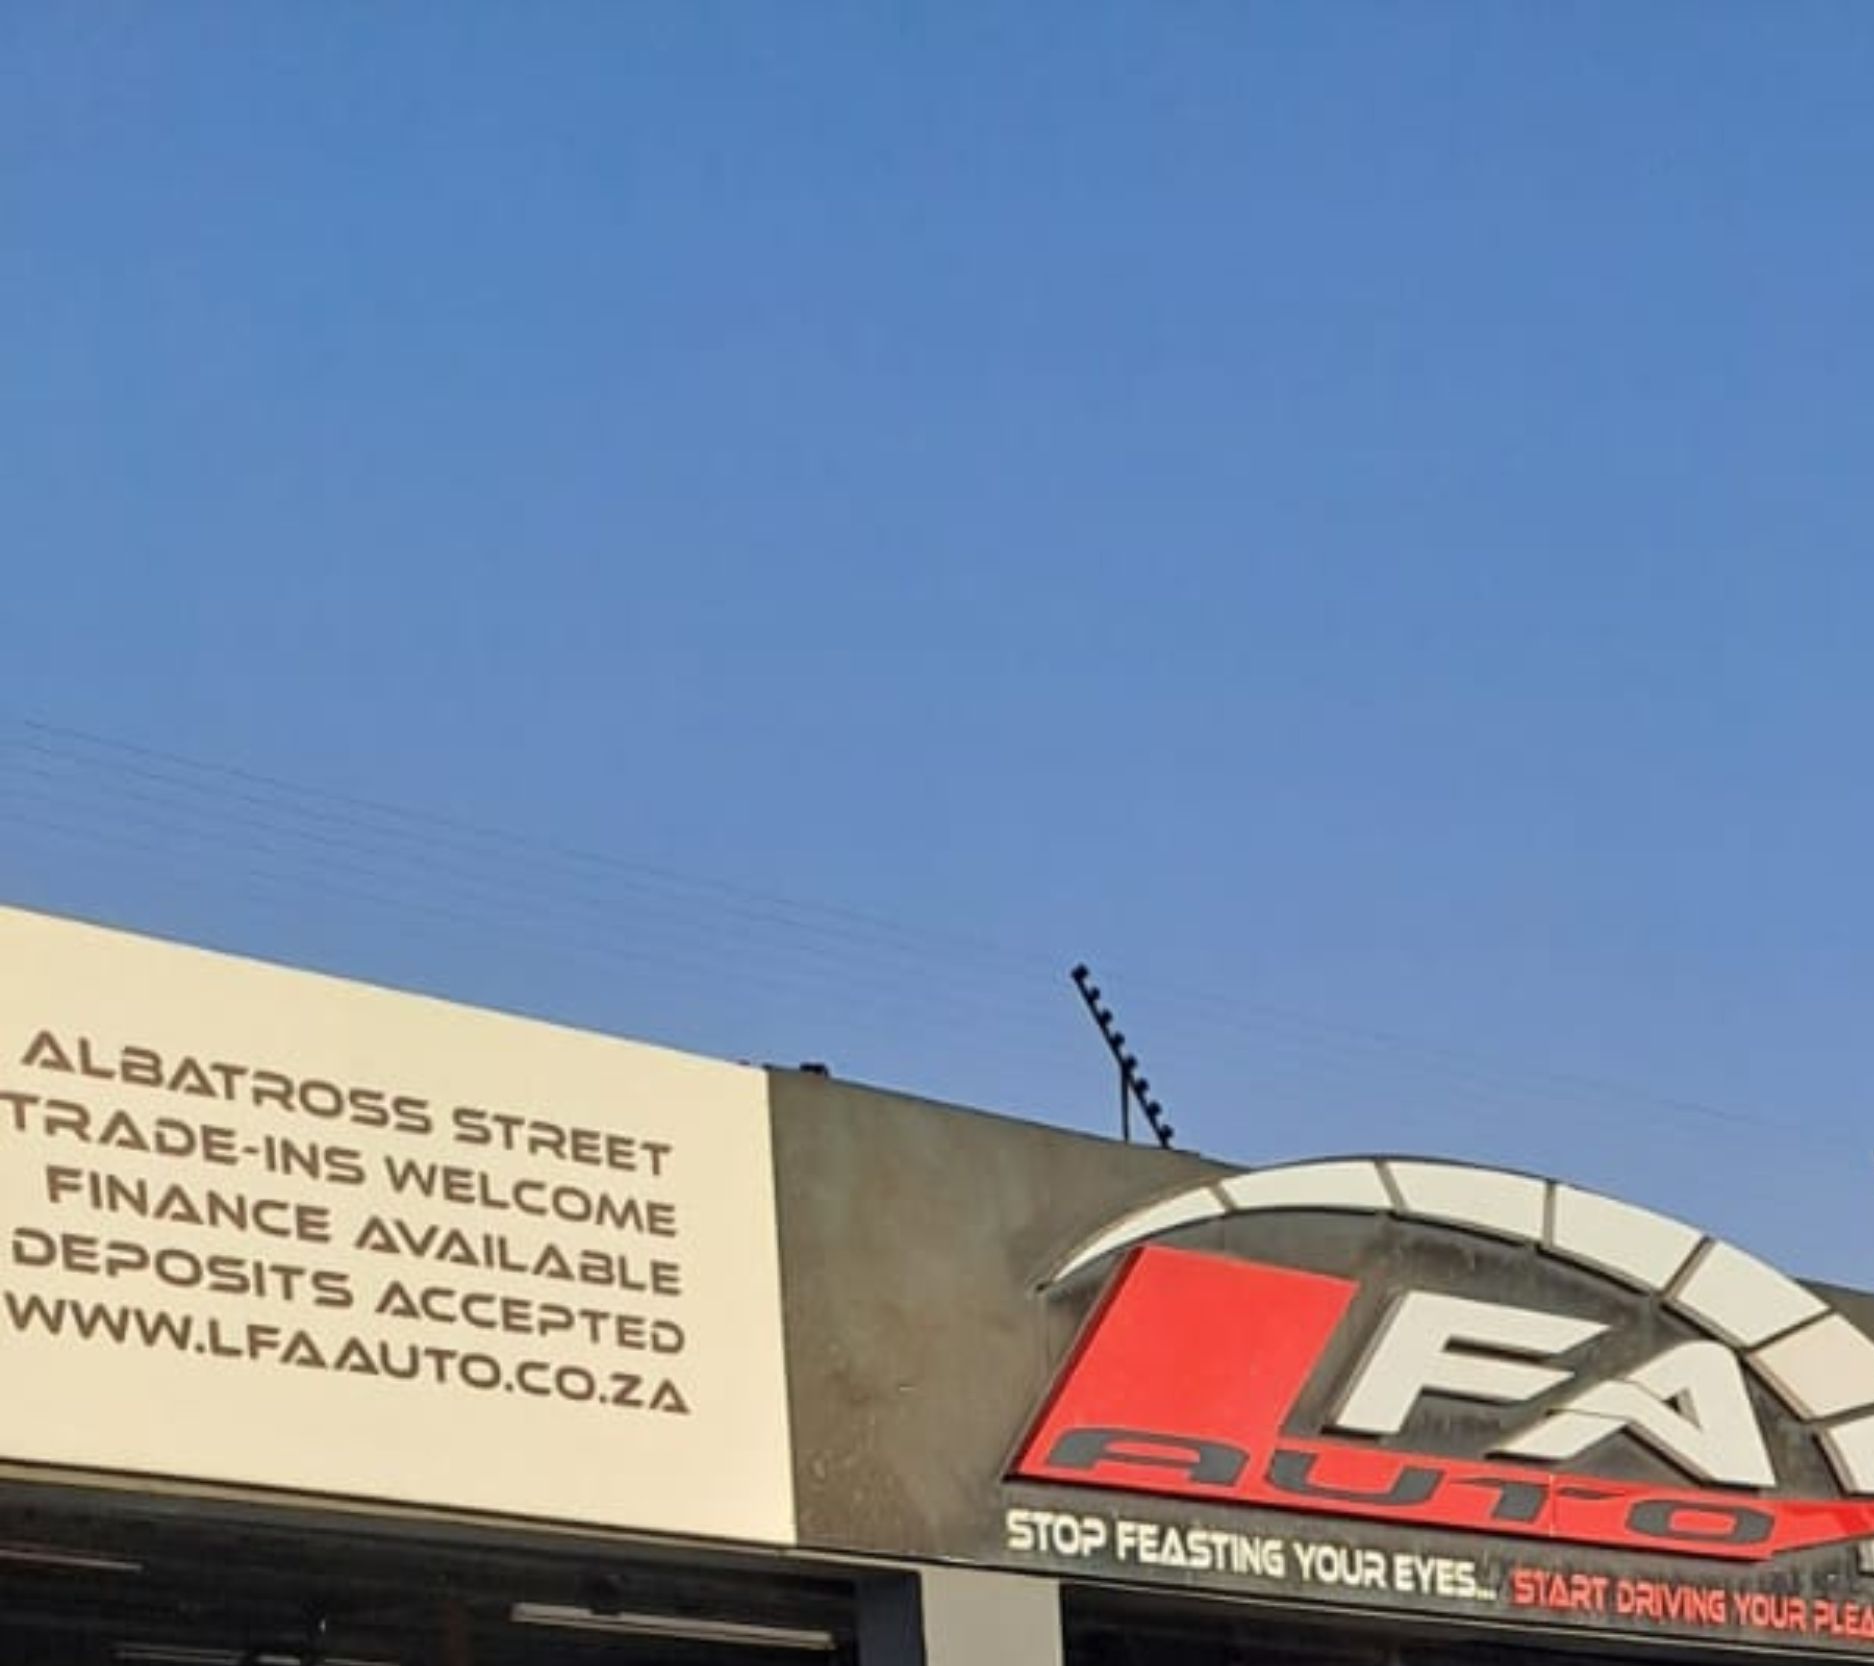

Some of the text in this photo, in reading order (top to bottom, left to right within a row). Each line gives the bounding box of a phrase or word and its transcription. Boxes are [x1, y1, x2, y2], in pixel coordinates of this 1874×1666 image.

[0, 1089, 679, 1238] TRADE-INS WELCOME
[20, 1029, 673, 1176] ALBATROSS STREET
[11, 1226, 685, 1354] DEPOSITS ACCEPTED
[45, 1164, 682, 1297] FINANCE AVAILABLE
[3, 1289, 691, 1415] WWW.LFAAUTO.CO.ZA
[1046, 1427, 1778, 1547] AUTO
[1005, 1508, 1498, 1600] STOP FEASTING YOUR EYES...
[1511, 1568, 1610, 1611] START
[1616, 1578, 1726, 1624] DRIVING
[1732, 1592, 1807, 1632] YOUR
